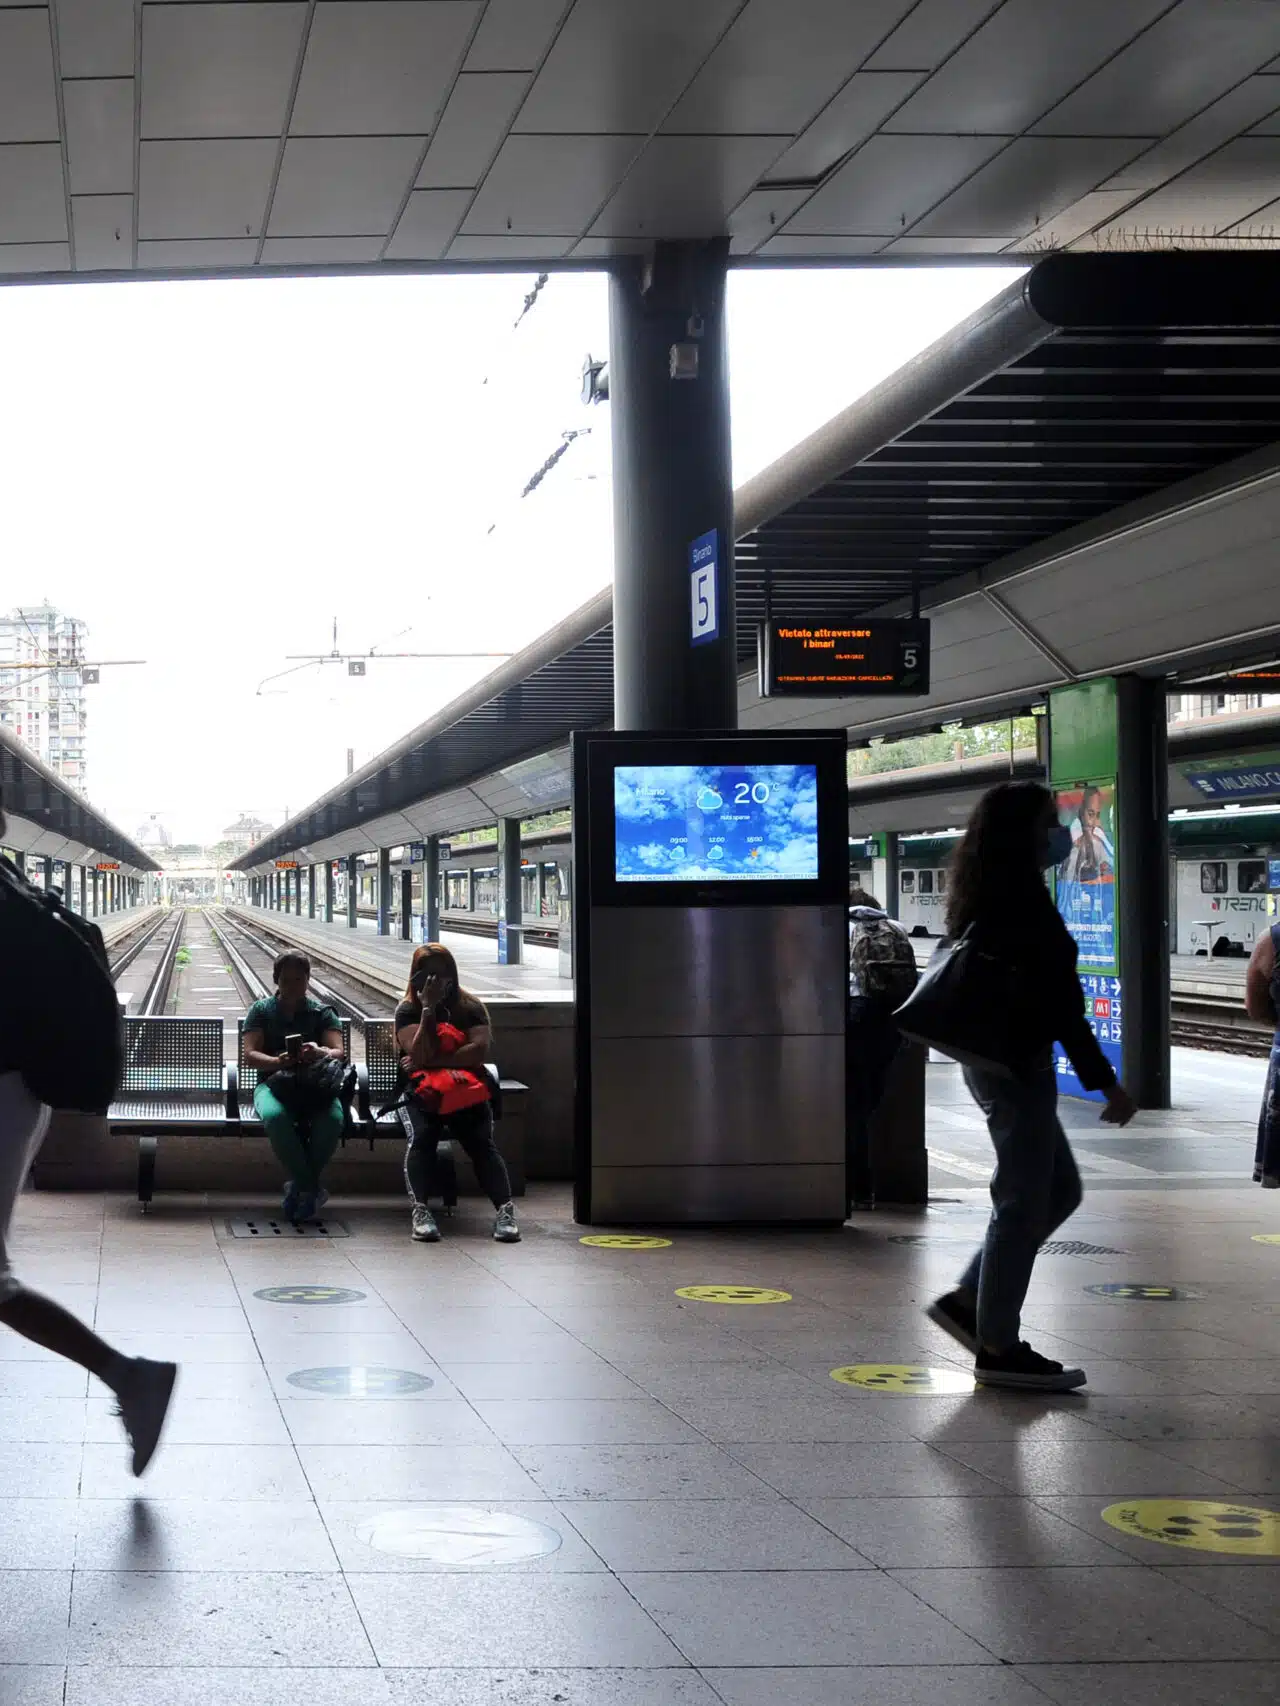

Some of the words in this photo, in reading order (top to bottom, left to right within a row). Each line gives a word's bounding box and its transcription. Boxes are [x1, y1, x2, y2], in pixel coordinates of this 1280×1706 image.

[698, 573, 709, 627] 5
[778, 628, 812, 638] Vietato
[813, 628, 871, 638] attraversare
[809, 640, 835, 648] binari
[903, 649, 917, 668] 5
[354, 664, 361, 673] 5
[1216, 773, 1269, 792] MILANO
[635, 787, 666, 797] Milano
[733, 782, 770, 804] 20
[441, 850, 448, 859] 6
[1095, 1001, 1109, 1014] M1
